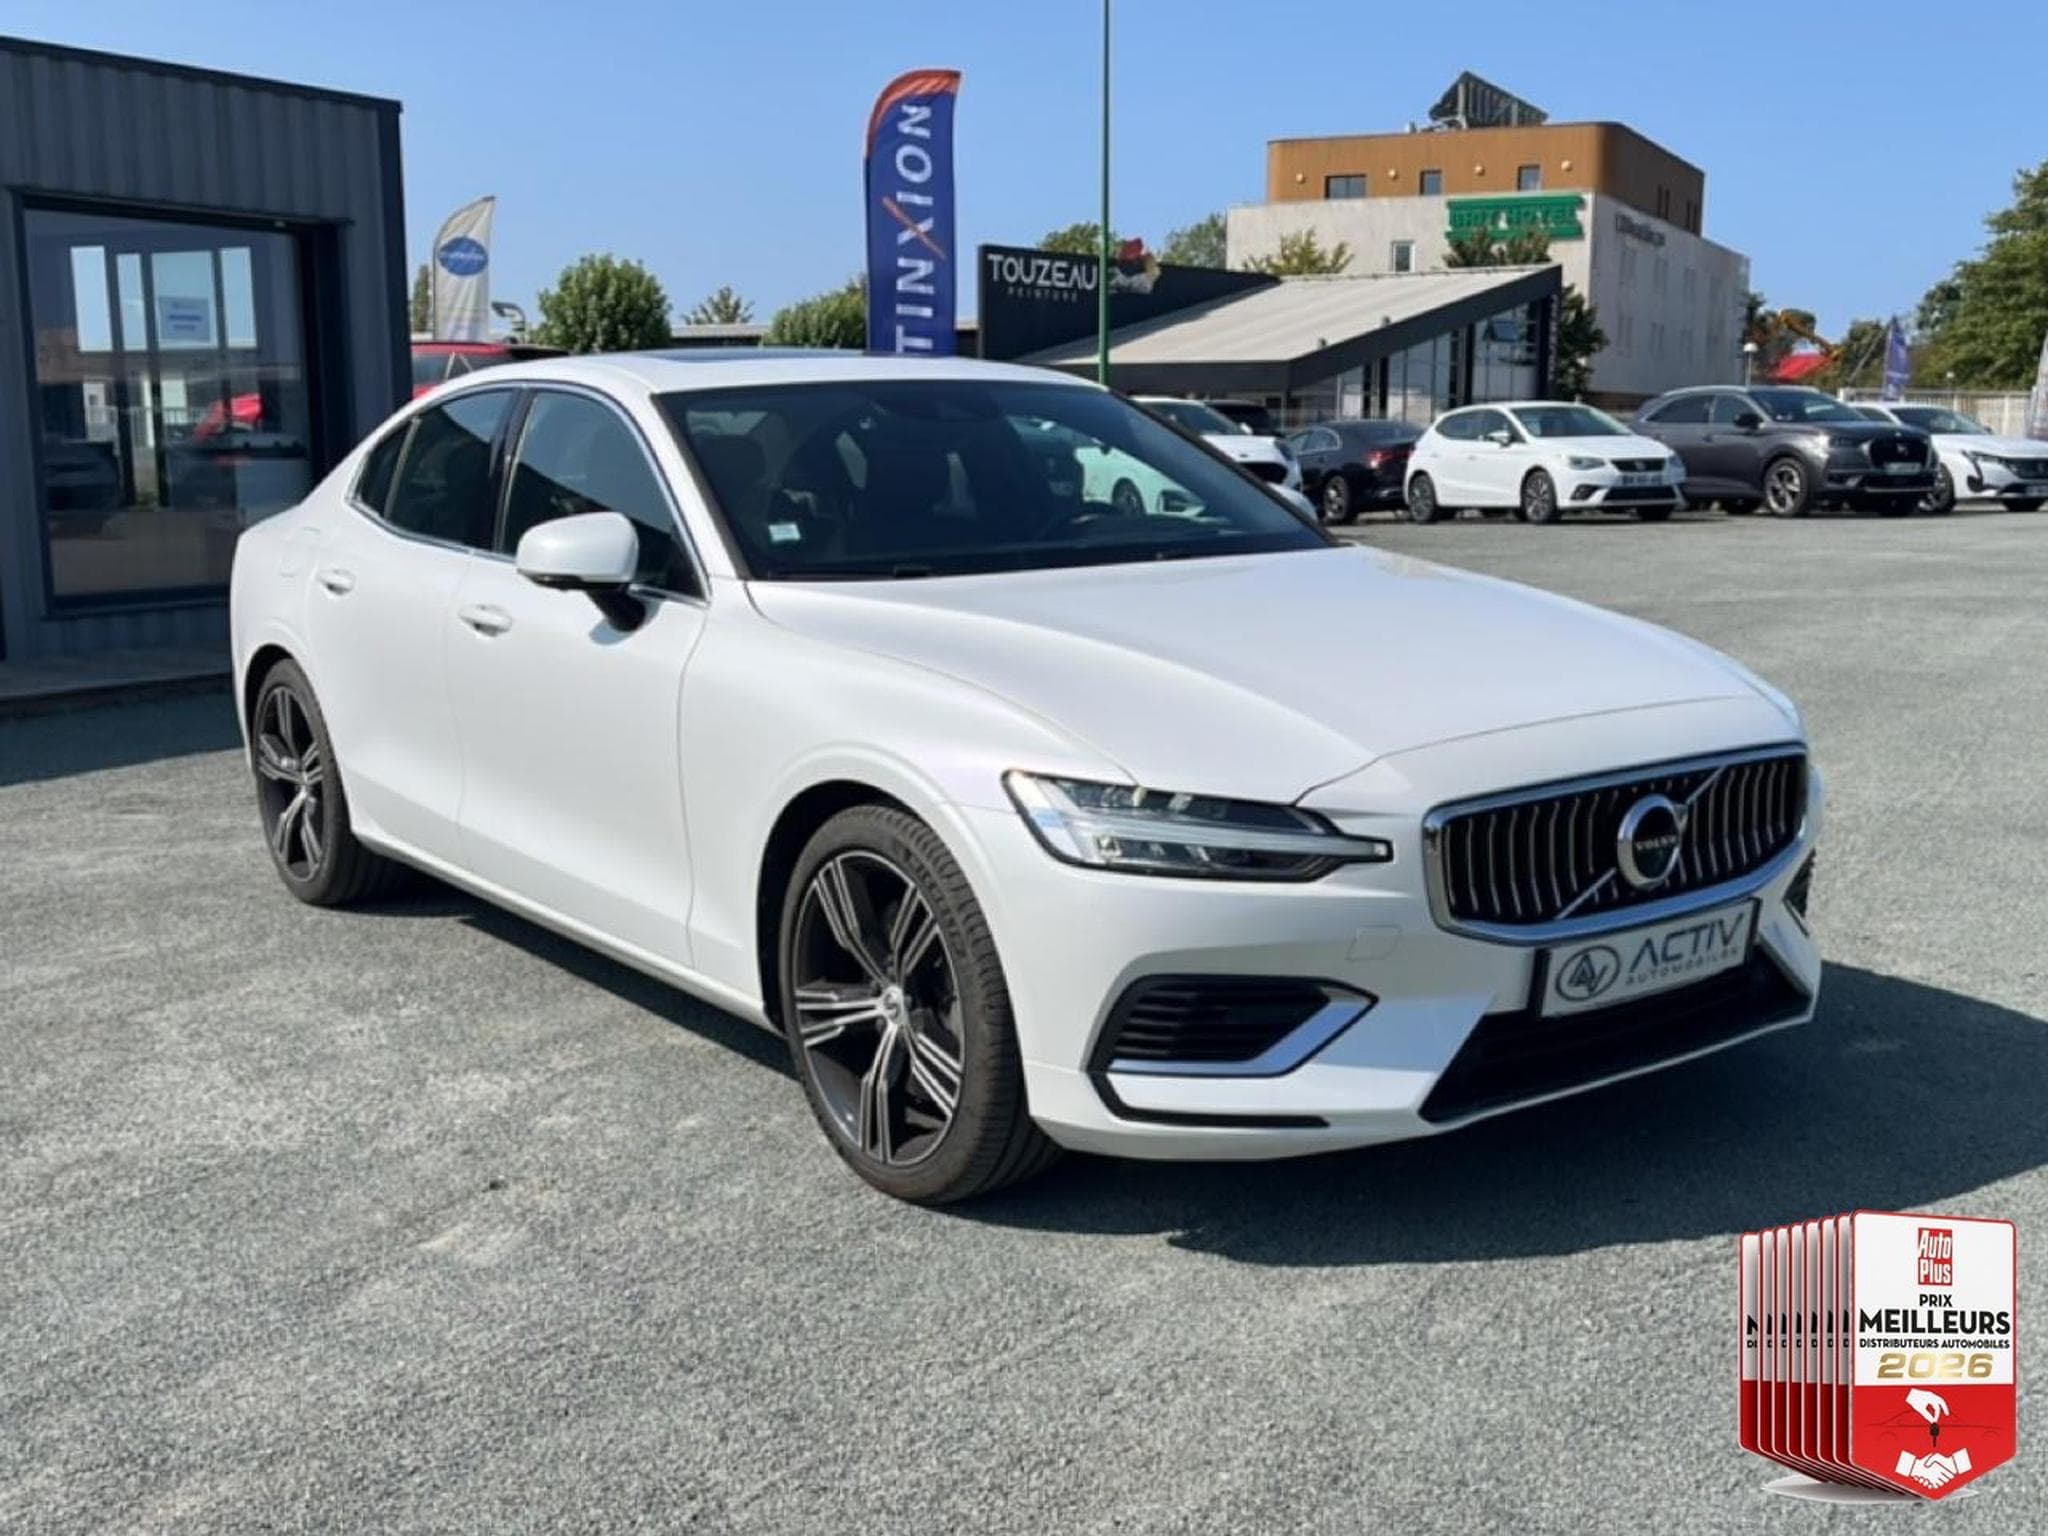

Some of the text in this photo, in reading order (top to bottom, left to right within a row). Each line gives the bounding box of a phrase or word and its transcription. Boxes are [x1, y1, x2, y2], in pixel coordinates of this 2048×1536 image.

[987, 253, 1098, 290] TOUZEAU
[1629, 912, 1744, 974] ACTIV
[1625, 948, 1739, 986] AUTOMOBILES
